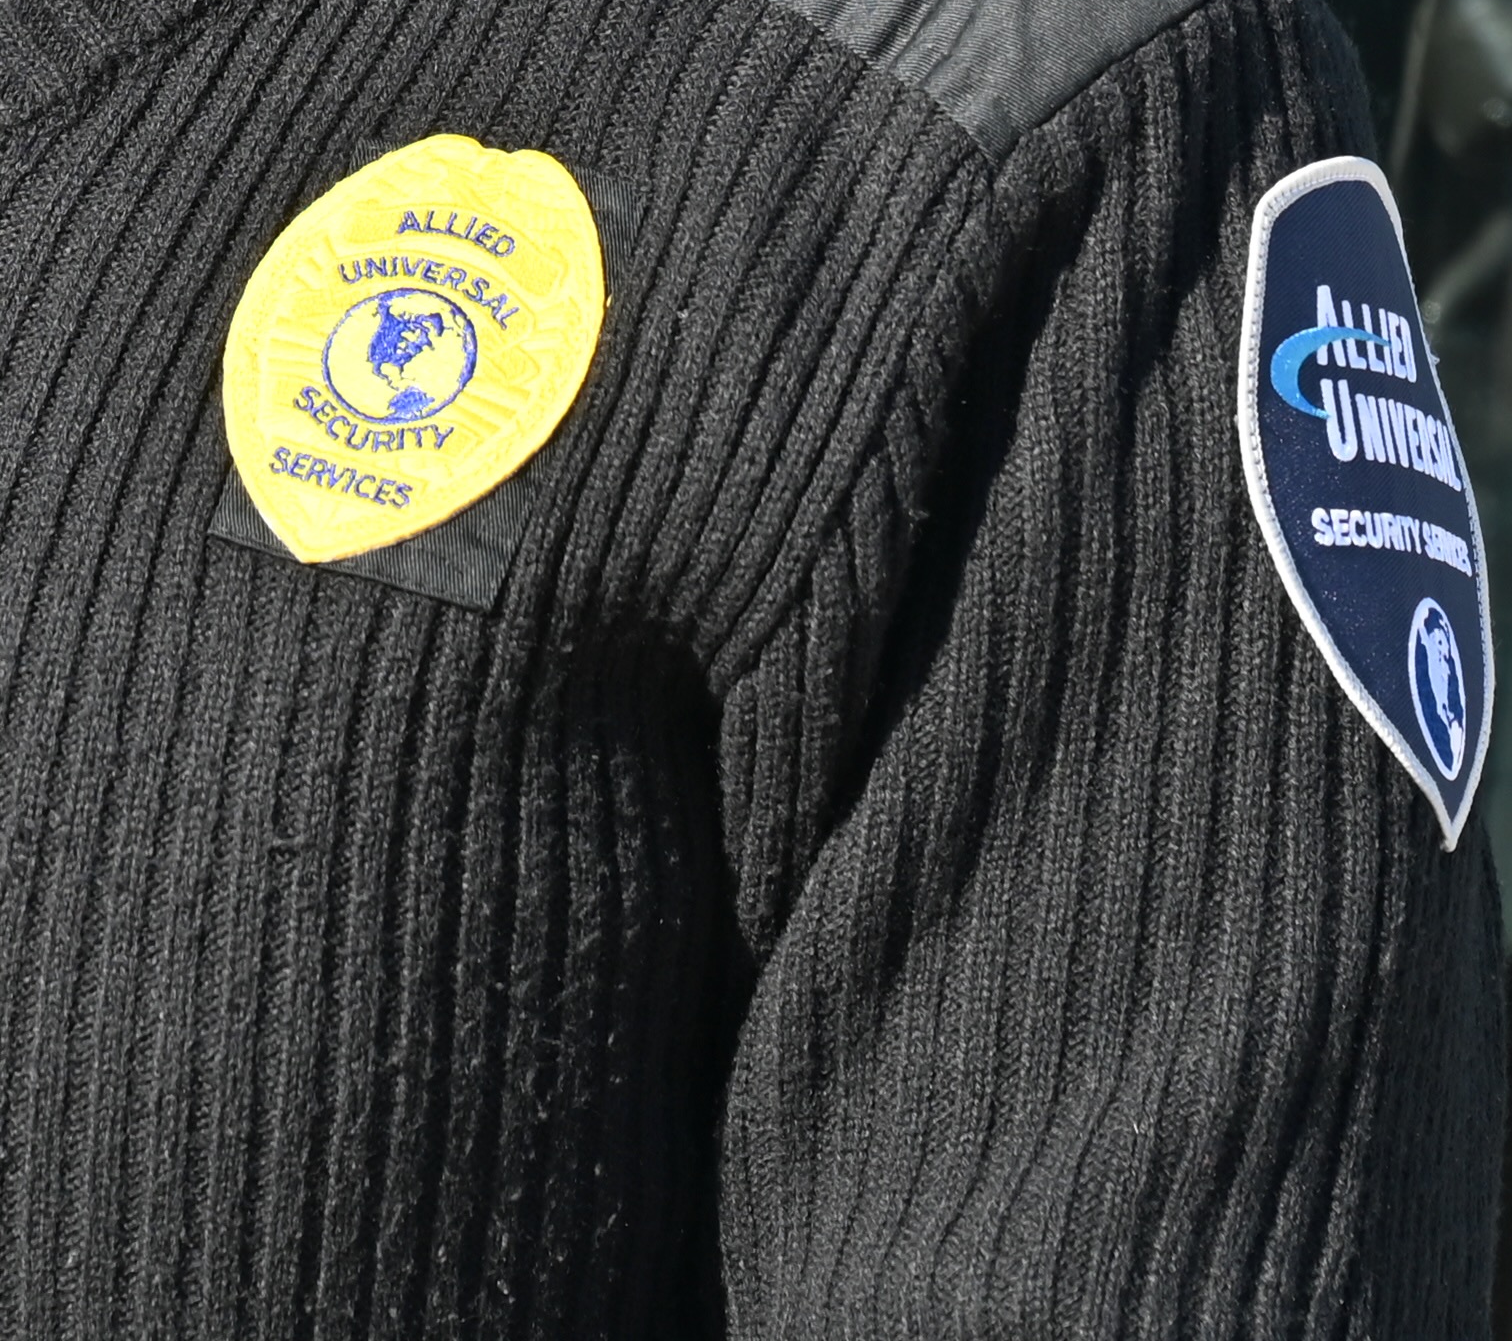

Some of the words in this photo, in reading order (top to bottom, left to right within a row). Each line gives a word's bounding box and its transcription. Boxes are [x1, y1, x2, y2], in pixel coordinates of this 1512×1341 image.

[397, 210, 516, 259] ALLIED
[339, 255, 523, 331] UNIVERSAL
[1317, 284, 1417, 383] ALLIED
[293, 384, 454, 452] SECURITY
[1320, 378, 1462, 492] UNIVERSAL
[269, 446, 413, 509] SERVICES
[1311, 507, 1422, 554] SECURITY
[1422, 521, 1473, 578] SERVICES
